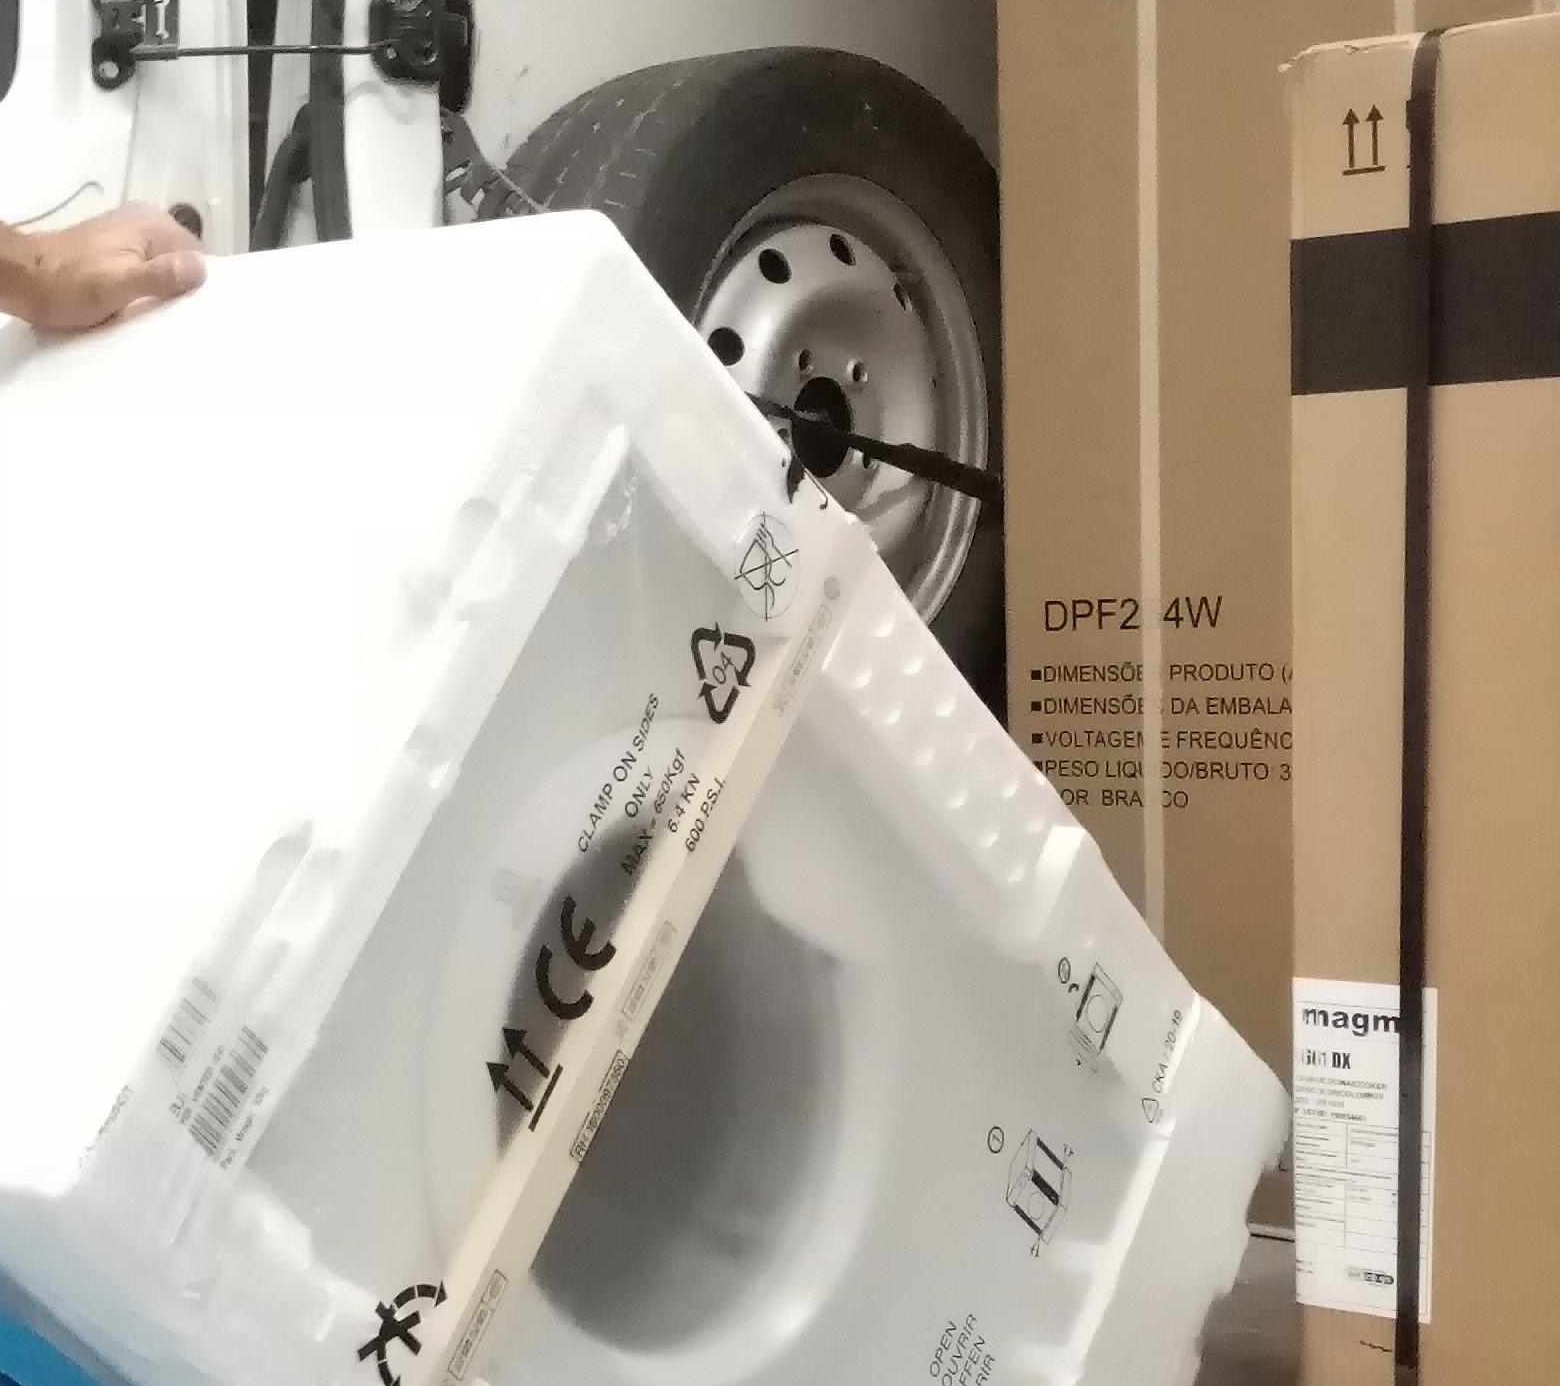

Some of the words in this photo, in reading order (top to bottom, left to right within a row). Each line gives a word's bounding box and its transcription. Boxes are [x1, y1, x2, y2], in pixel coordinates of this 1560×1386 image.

[1044, 595, 1223, 632] DPF24W
[1043, 661, 1144, 683] DIMENSÕE
[1169, 663, 1275, 682] PRODUTO
[1043, 694, 1163, 715] DIMENSÕE
[1171, 697, 1200, 715] DA
[578, 783, 613, 853] CLAMP
[613, 751, 637, 782] ON
[633, 692, 659, 752] SIDES
[1045, 760, 1099, 778] PESO
[1105, 760, 1270, 782] LIQDO/BRUTO
[624, 765, 655, 818] ONLY
[680, 772, 701, 804] KN
[1060, 788, 1089, 807] OR
[1101, 788, 1189, 809] BRACO
[685, 818, 705, 853] 600
[929, 1320, 958, 1378] OPEN
